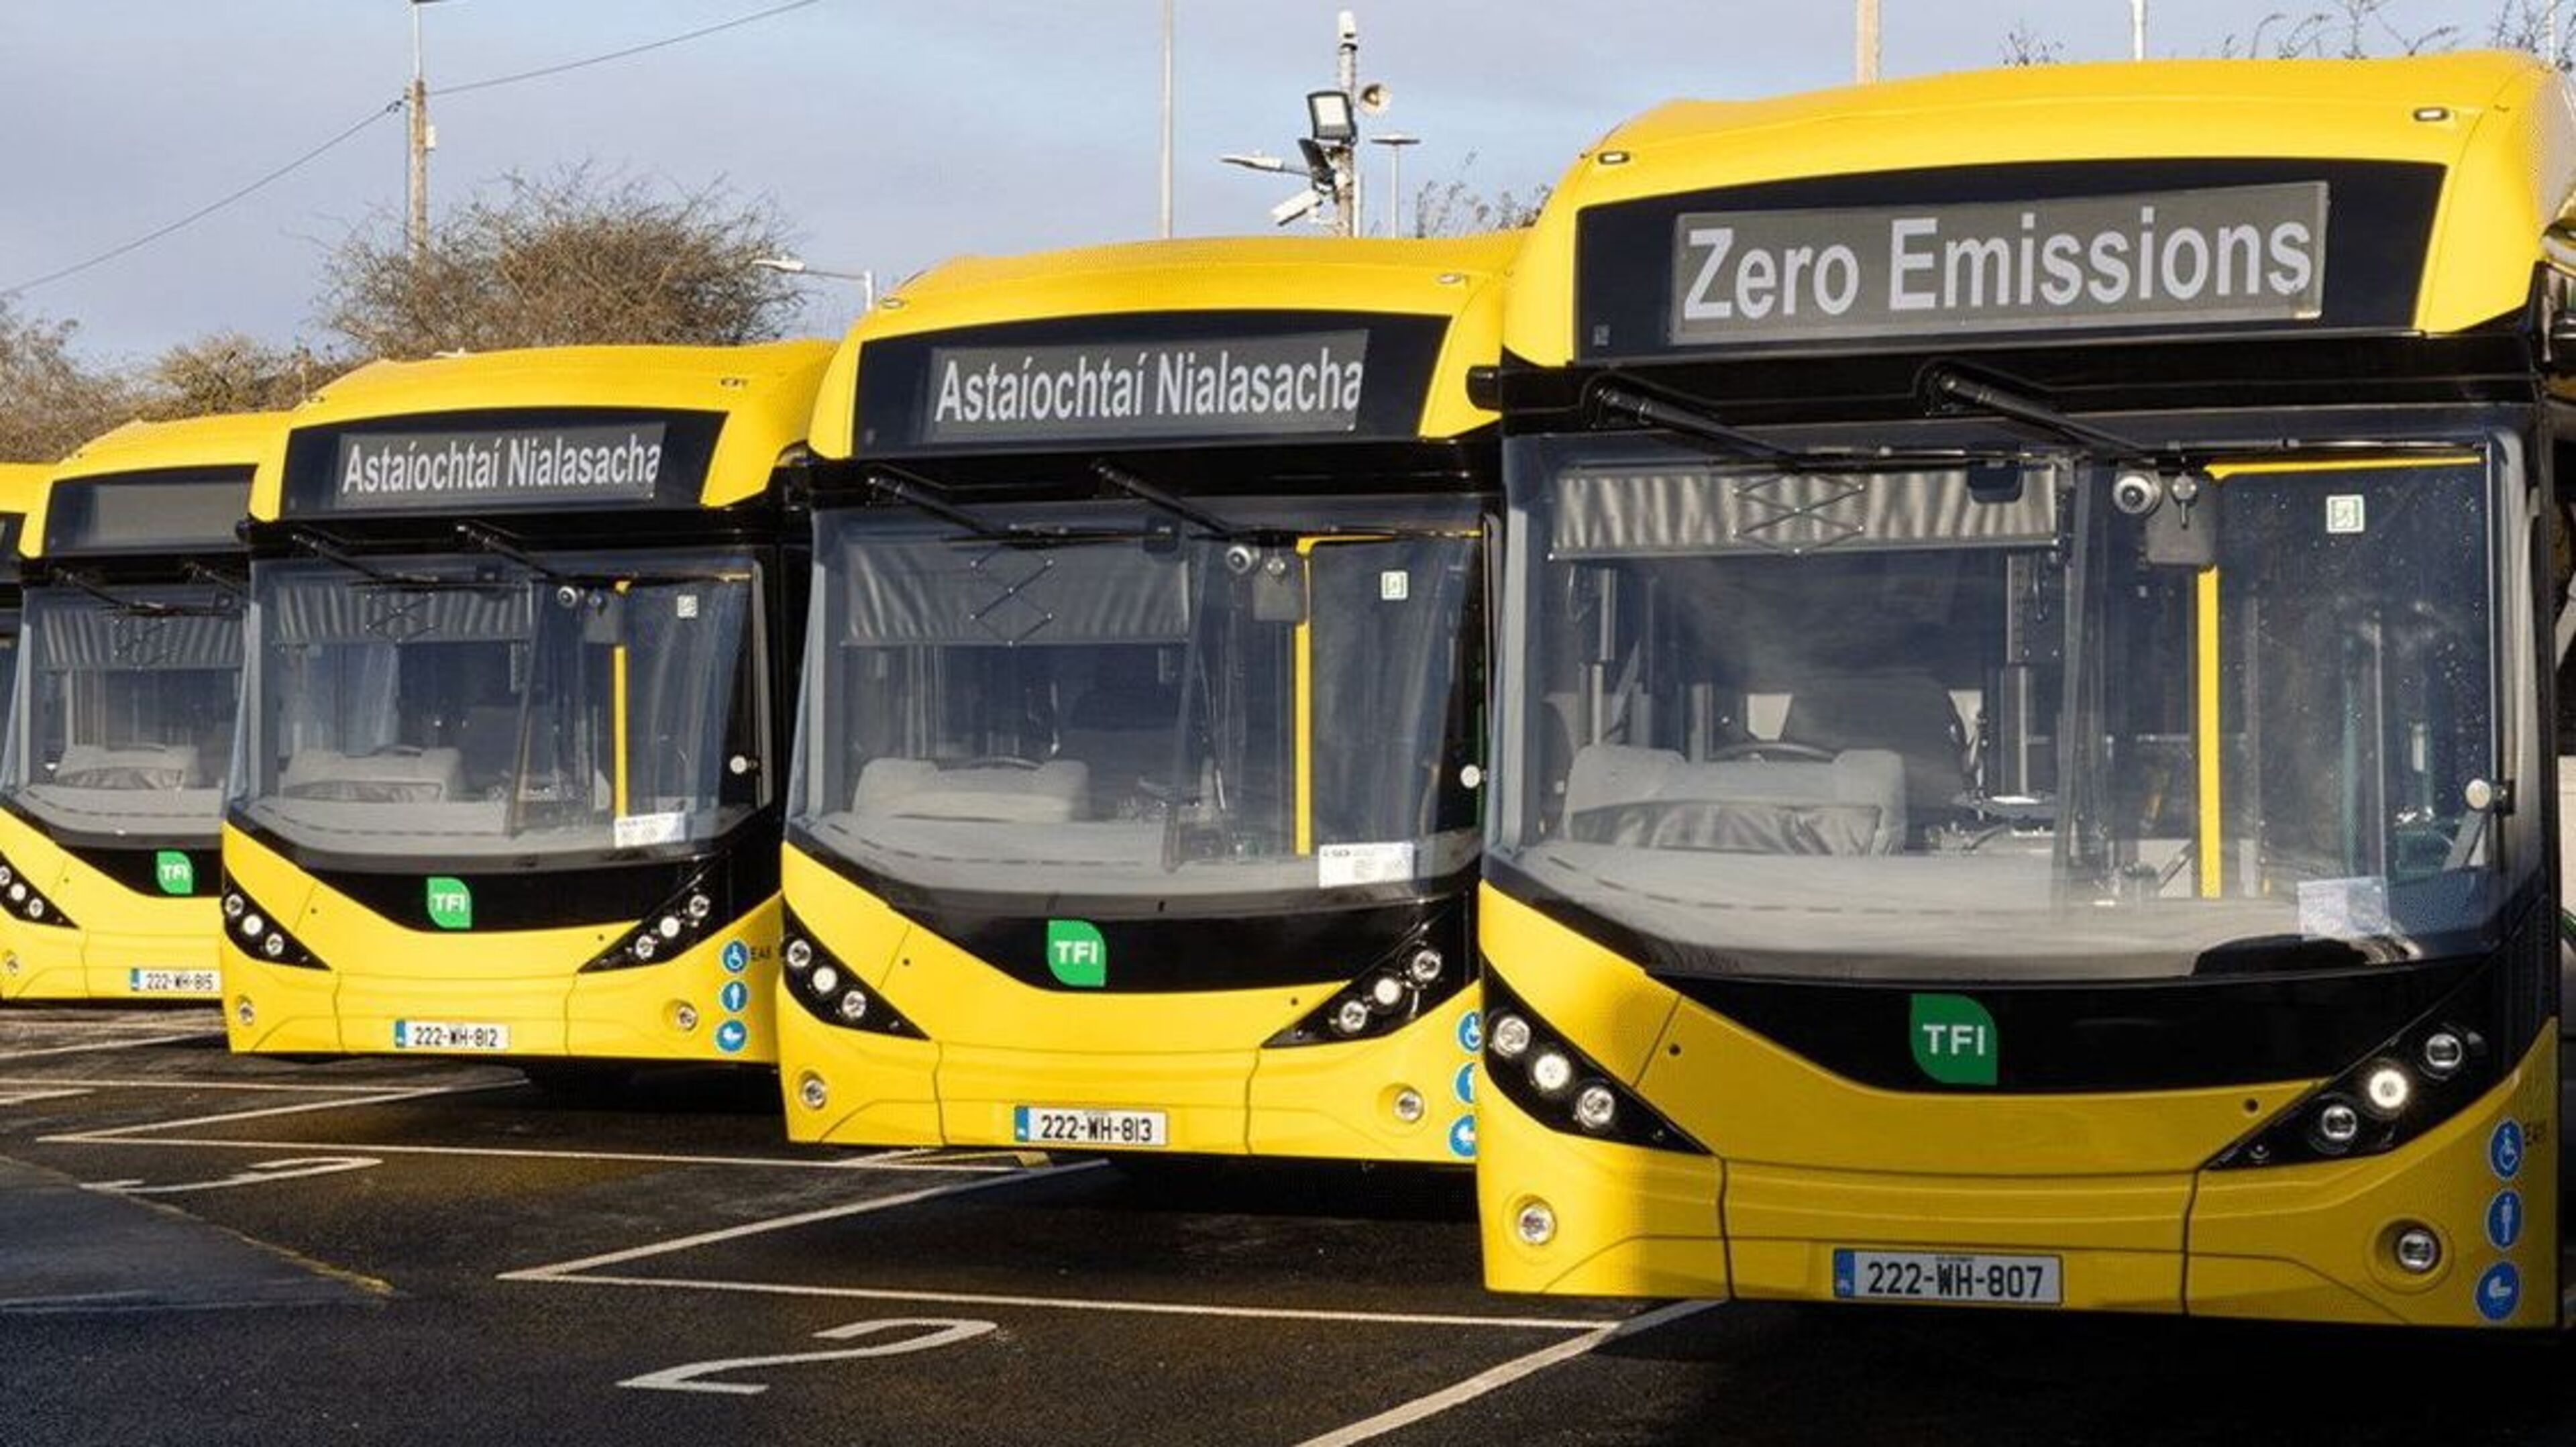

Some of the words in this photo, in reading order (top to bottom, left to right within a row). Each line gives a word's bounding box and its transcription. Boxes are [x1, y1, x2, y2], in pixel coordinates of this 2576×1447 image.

[1684, 227, 1860, 320] Zero
[1889, 206, 2312, 313] Emissions
[935, 352, 1147, 422] Astaíochtaí
[1156, 347, 1364, 415] Nialasacha
[342, 437, 501, 493] Astaíochtaí
[507, 433, 661, 488] Nialasacha
[160, 865, 188, 881] TFI
[431, 893, 466, 912] TFI
[1055, 940, 1098, 965] TFI
[415, 1026, 498, 1048] 222-WH-812
[1922, 1024, 1985, 1057] TFI
[1041, 1114, 1152, 1142] 222-WH-813
[1867, 1261, 2043, 1298] 222-WH-807
[615, 1318, 998, 1394] 2
